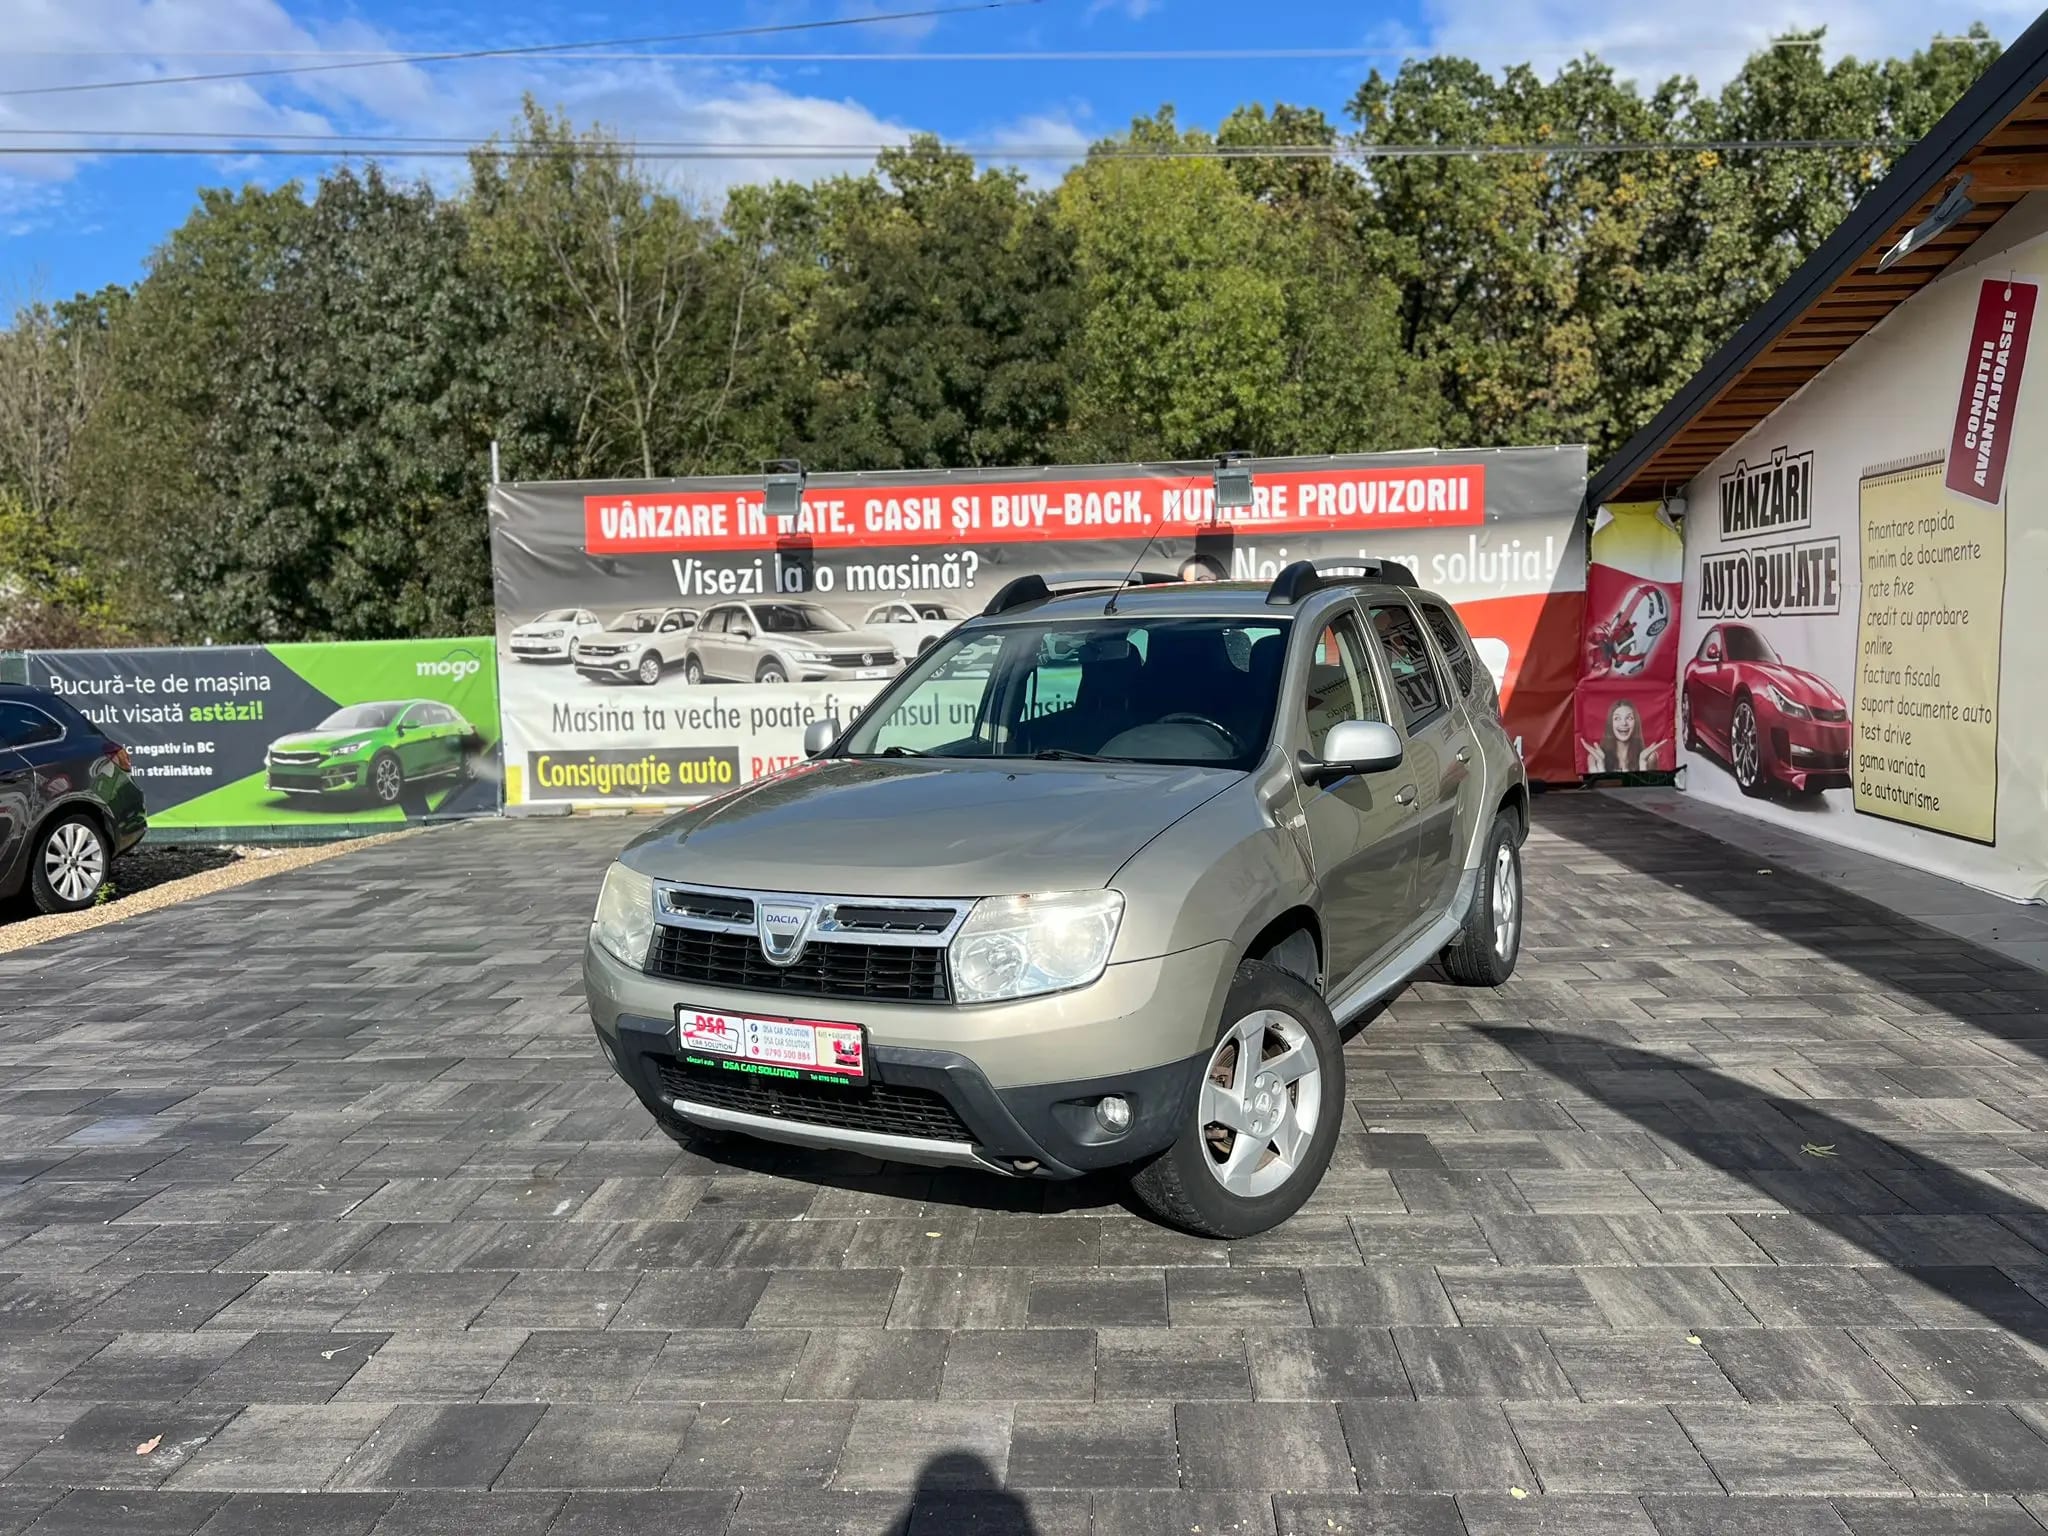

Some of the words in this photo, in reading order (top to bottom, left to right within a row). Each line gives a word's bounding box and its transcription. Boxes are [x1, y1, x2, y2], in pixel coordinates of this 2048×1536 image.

[1964, 341, 1995, 449] CONDITII
[1973, 310, 2017, 487] AVANTAJOASE!
[1721, 455, 1810, 534] VÂNZĂRI
[600, 500, 728, 539] VÂNZARE
[735, 497, 767, 535] ÎN
[865, 497, 941, 532] CASH
[952, 496, 980, 536] ȘI
[991, 490, 1152, 528] BUY-BACK,
[1298, 477, 1469, 516] PROVIZORII
[1867, 520, 1915, 542] finantare
[1918, 509, 1955, 539] rapida
[1234, 547, 1288, 580] Noi
[1868, 549, 1897, 570] minim
[1900, 545, 1914, 566] de
[1917, 540, 1981, 565] documente
[672, 558, 764, 596] Visezi
[775, 553, 803, 594] la
[814, 565, 834, 593] o
[1701, 557, 1750, 611] AUTO
[1755, 546, 1837, 609] RULATE
[1868, 580, 1890, 598] rate
[1893, 575, 1914, 597] fixe
[1866, 605, 1898, 626] credit
[1900, 610, 1913, 626] cu
[1916, 604, 1969, 632] aprobare
[1864, 635, 1893, 655] online
[416, 660, 480, 682] mogo
[1863, 663, 1901, 685] factura
[1904, 664, 1940, 688] fiscala
[50, 675, 156, 696] Bucură-te
[161, 673, 189, 694] de
[194, 672, 271, 697] mașina
[122, 704, 184, 723] visată
[189, 701, 264, 722] astăzi!
[642, 705, 666, 731] ta
[674, 696, 741, 730] veche
[751, 696, 816, 736] poate
[1861, 696, 1894, 717] suport
[1897, 695, 1959, 721] documente
[1962, 704, 1992, 724] auto
[1860, 722, 1881, 740] test
[1884, 723, 1912, 745] drive
[135, 742, 181, 757] negativ
[197, 741, 215, 753] BC
[147, 765, 213, 777] străinătate
[537, 755, 671, 793] Consignație
[678, 756, 732, 784] auto
[1859, 754, 1885, 773] gama
[1887, 755, 1926, 778] variata
[1860, 775, 1873, 796] de
[1874, 783, 1940, 811] autoturisme
[766, 914, 799, 924] DACIA
[695, 1015, 726, 1035] DSA
[774, 1026, 784, 1034] CAR
[784, 1027, 810, 1038] SOLUTION
[704, 1041, 733, 1050] SOLUTION
[775, 1037, 784, 1046] CAR
[785, 1038, 810, 1048] SOLUTION
[723, 1060, 739, 1071] DSA
[740, 1063, 757, 1074] CAR
[758, 1066, 799, 1079] SOLUTION
